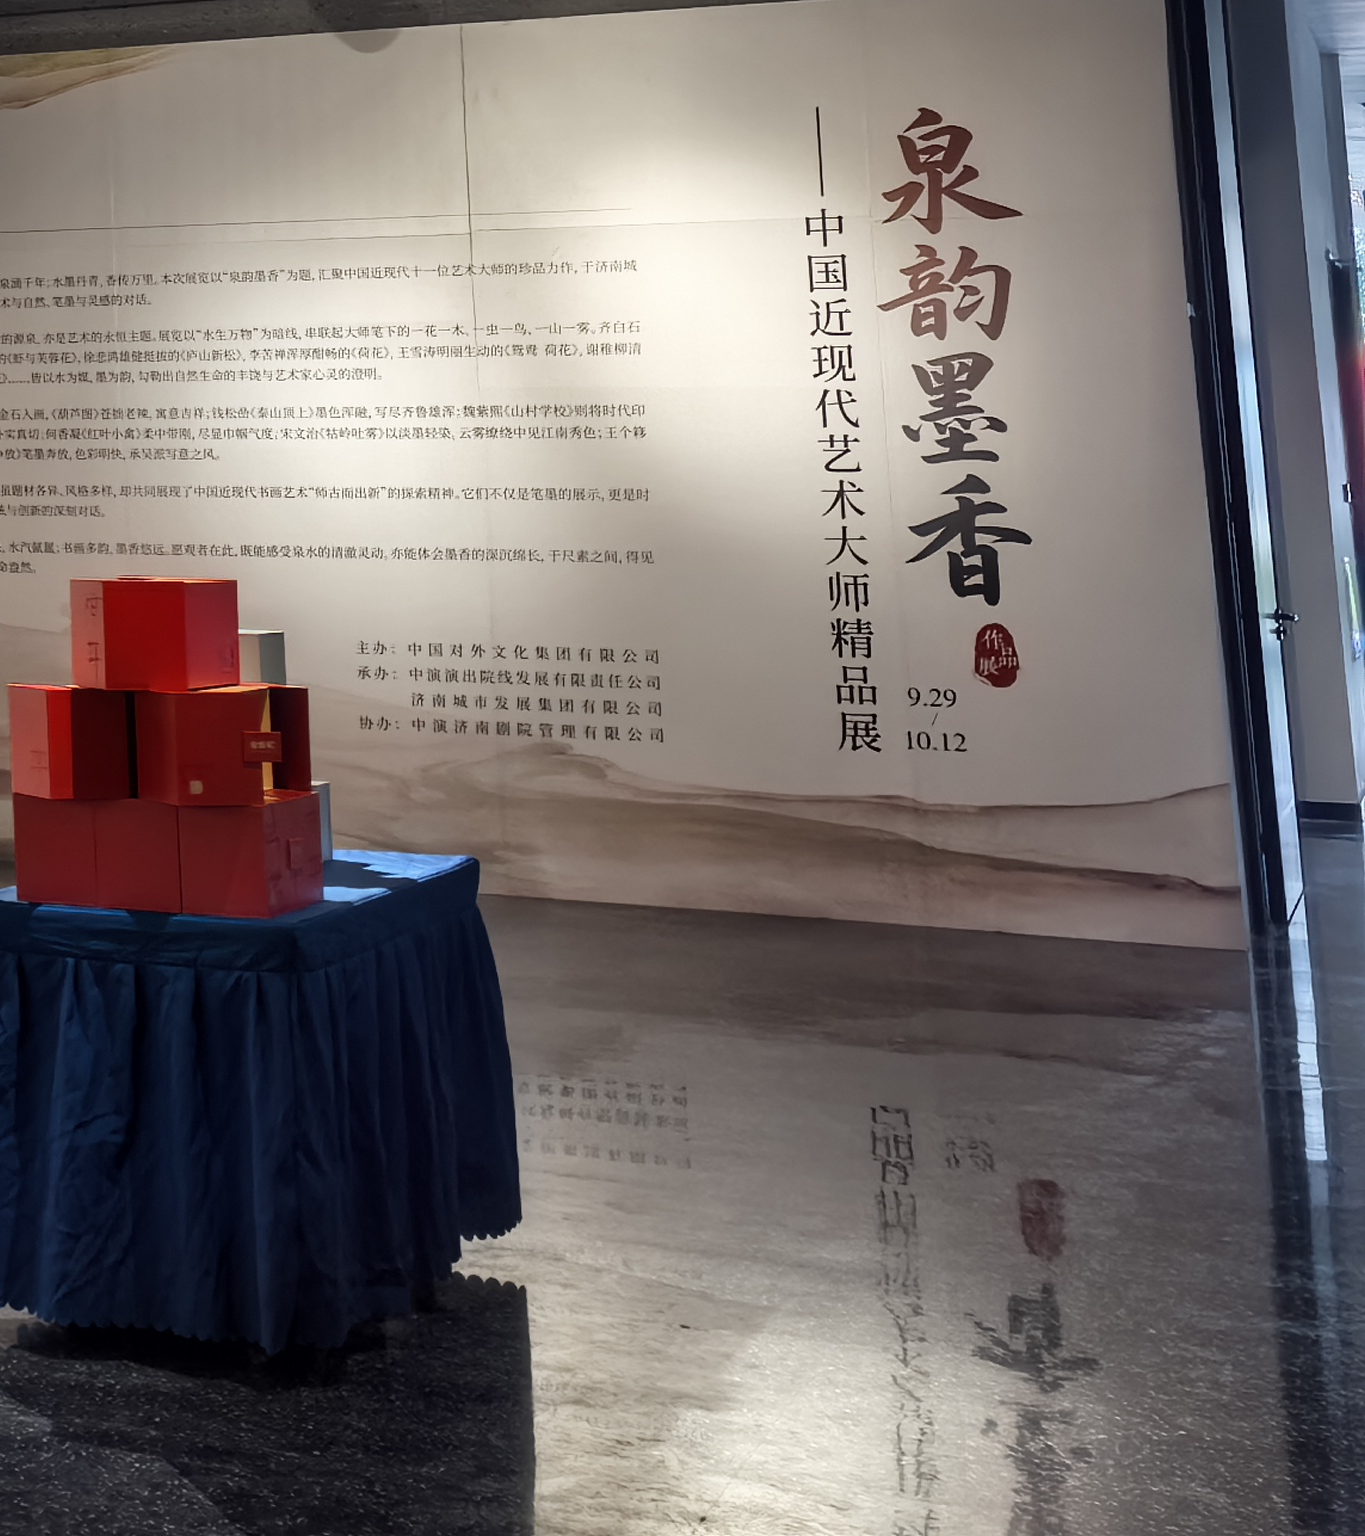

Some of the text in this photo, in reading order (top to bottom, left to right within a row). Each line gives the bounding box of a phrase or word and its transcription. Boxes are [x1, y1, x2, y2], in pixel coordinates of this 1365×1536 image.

[876, 106, 1033, 607] 泉韵墨香
[411, 692, 663, 718] 济南城市发展集团有限公司
[907, 687, 958, 709] 9.29
[906, 730, 968, 755] 10.12
